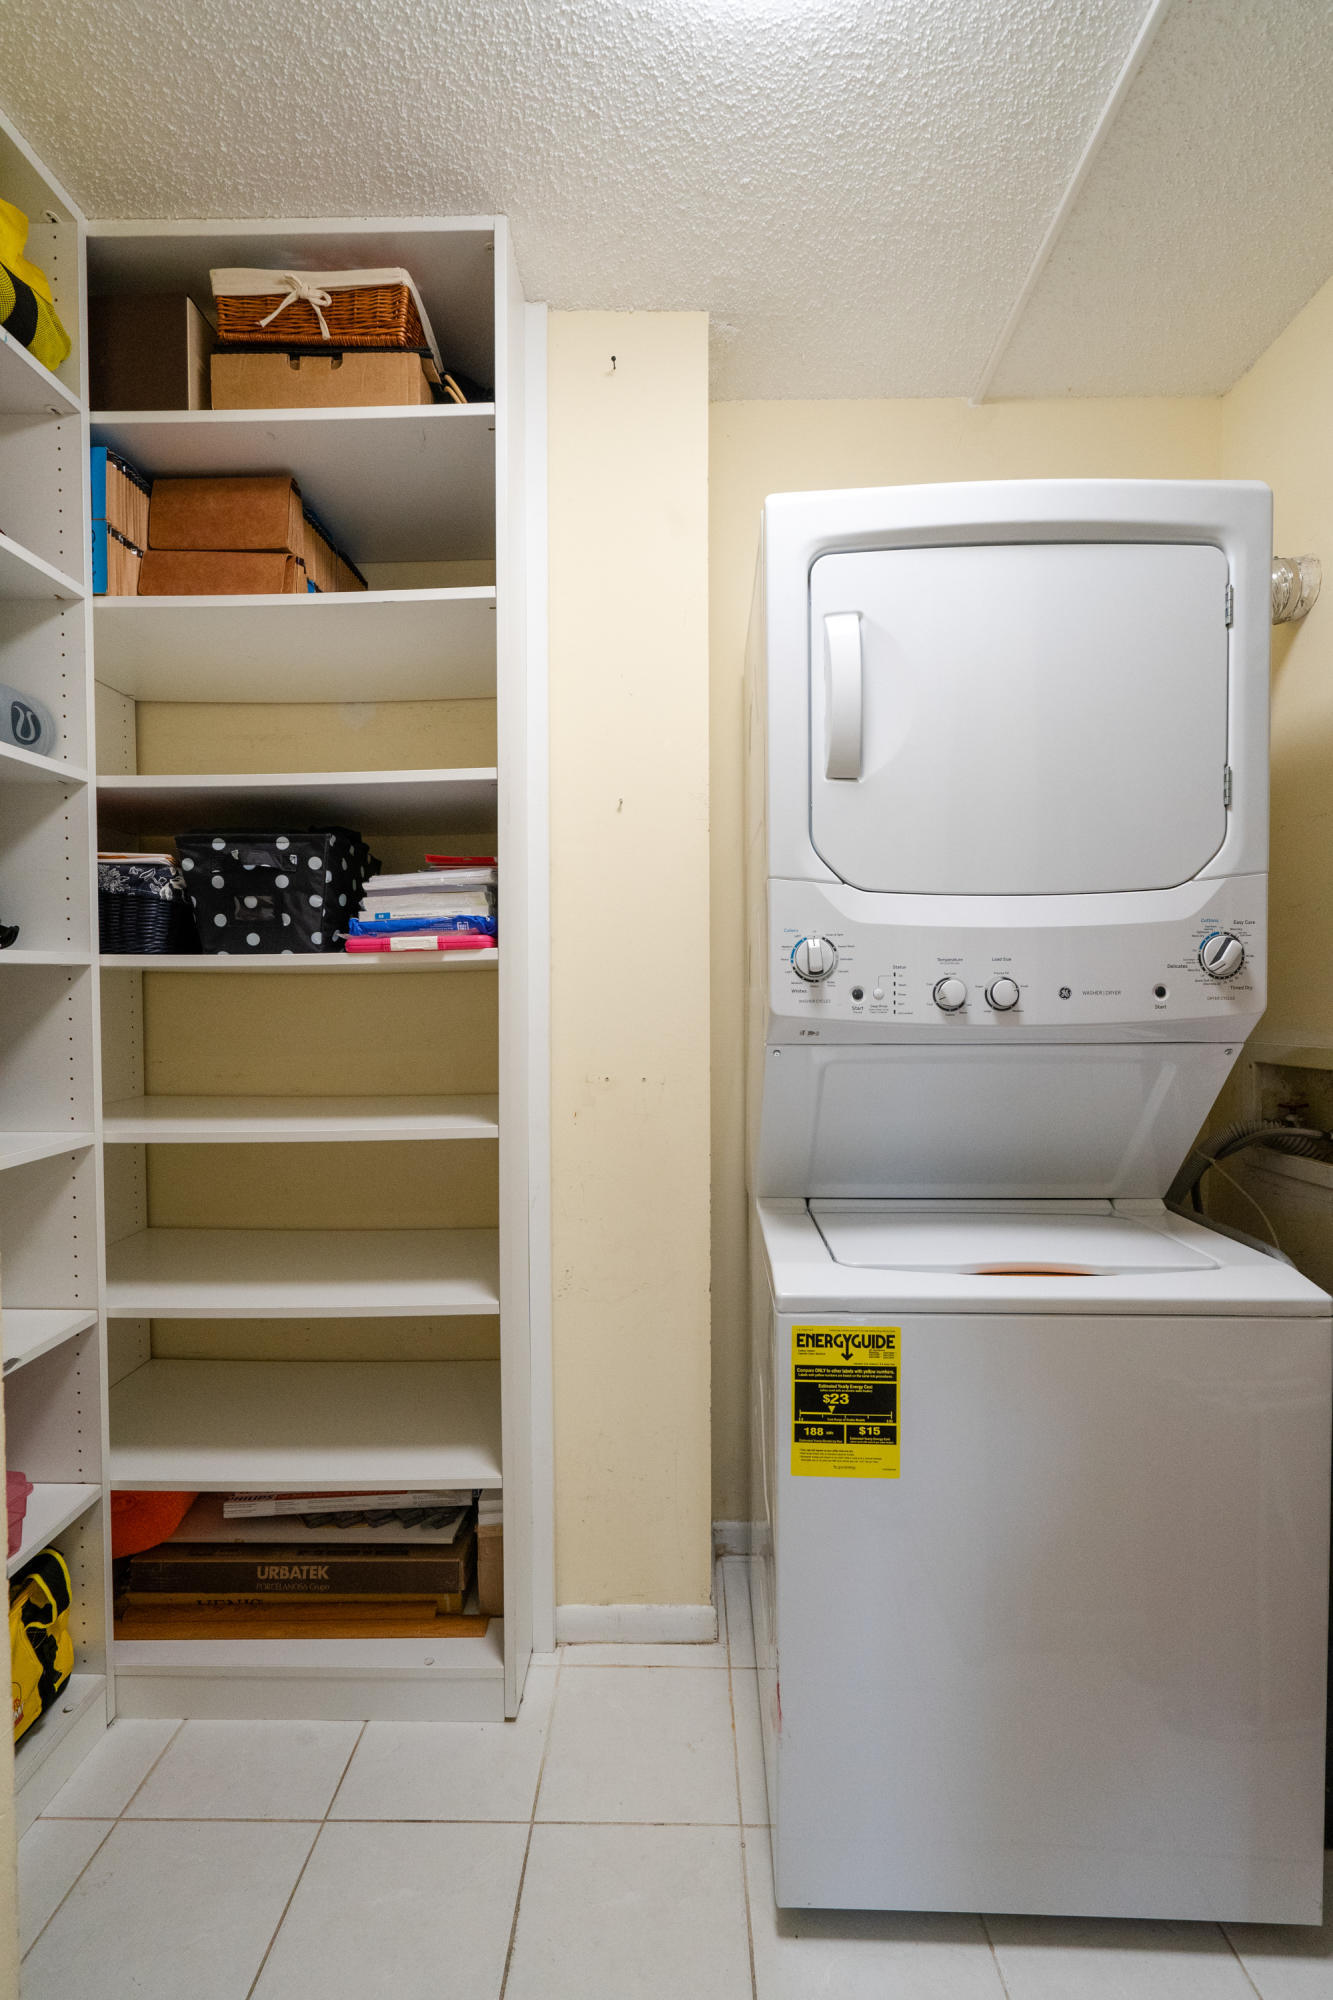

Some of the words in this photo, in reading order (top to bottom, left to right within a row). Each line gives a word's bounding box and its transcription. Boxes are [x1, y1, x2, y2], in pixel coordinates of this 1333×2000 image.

[796, 1333, 896, 1349] ENERGYGUIDE
[822, 1393, 850, 1405] $23
[803, 1427, 824, 1436] 188
[858, 1426, 881, 1436] $15
[256, 1565, 330, 1580] URBATEK
